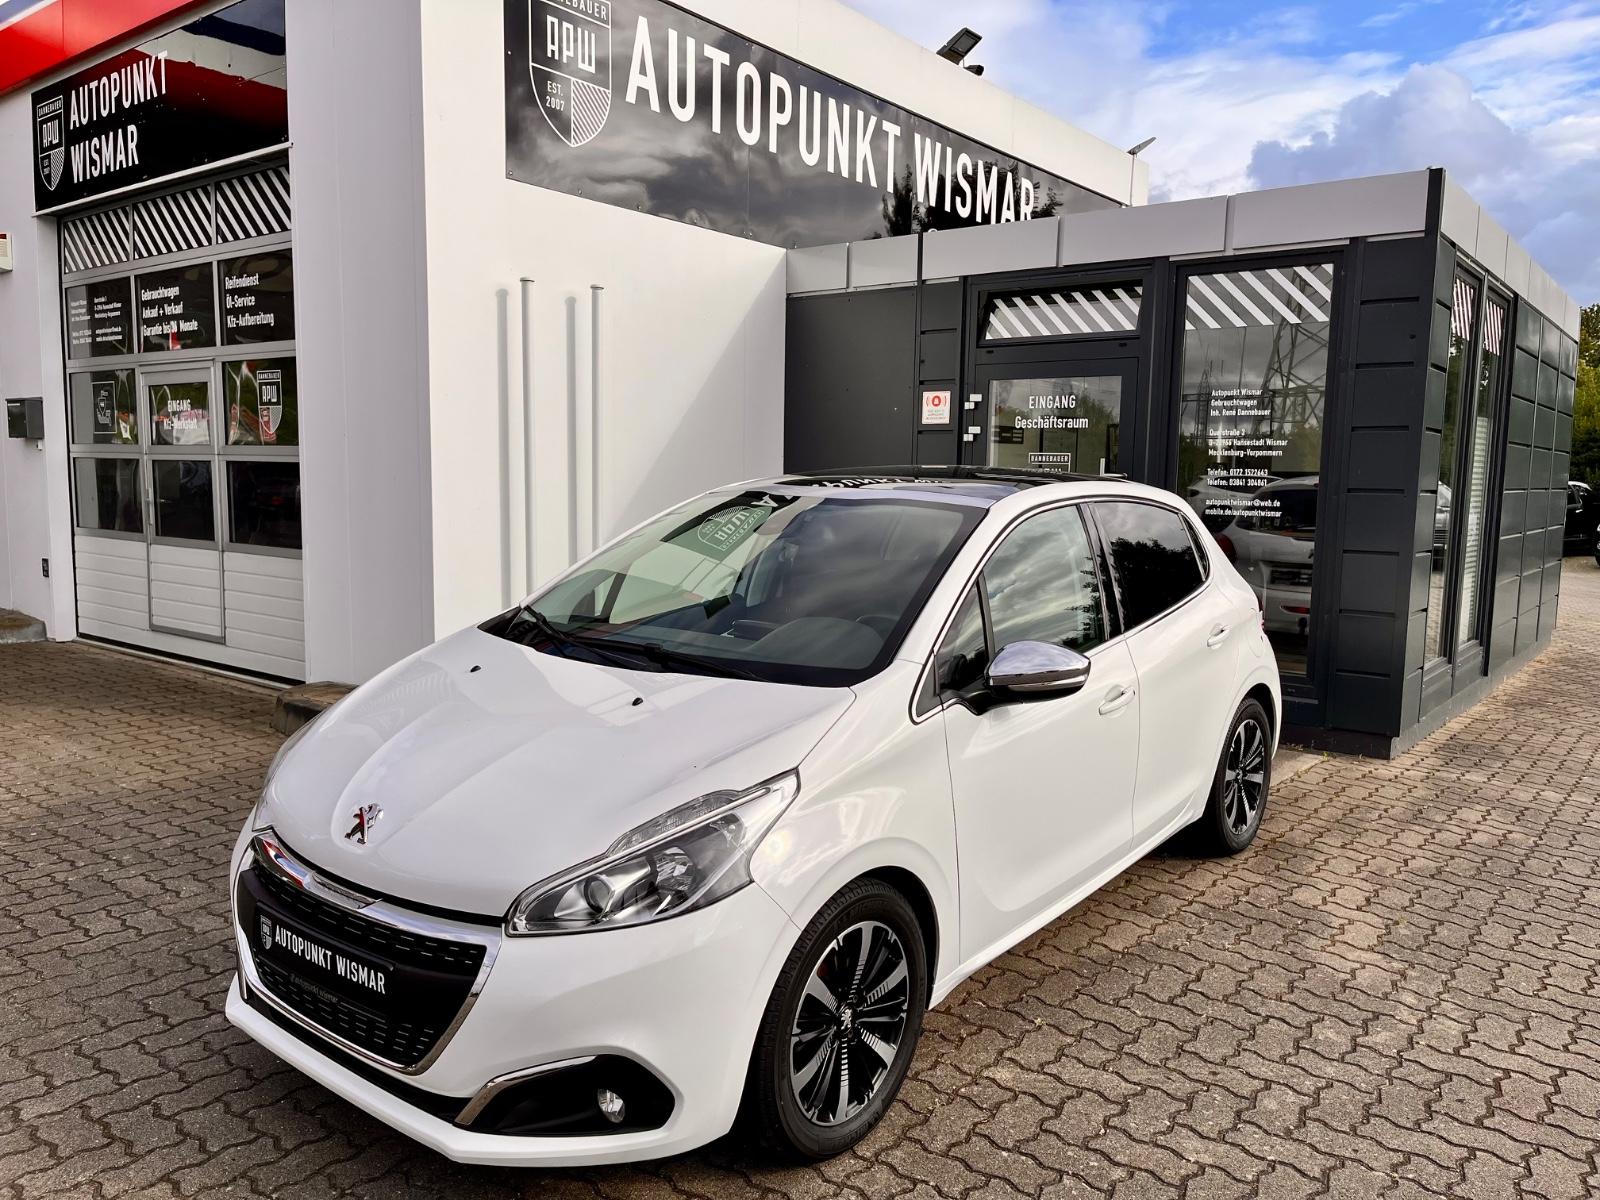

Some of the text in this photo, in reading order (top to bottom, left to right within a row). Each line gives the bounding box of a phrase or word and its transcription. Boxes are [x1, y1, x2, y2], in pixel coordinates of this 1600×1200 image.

[546, 14, 596, 74] APW
[70, 50, 168, 130] AUTOPUNKT
[547, 80, 564, 96] EST.
[545, 95, 565, 111] 2007
[625, 15, 1034, 225] AUTOPUNKT WISMAR
[70, 124, 139, 184] WISMAR
[225, 272, 260, 290] Reifendienst
[141, 286, 180, 301] Gebrauchtwagen
[226, 293, 256, 309] Öl-Service
[142, 304, 159, 319] Ankauf
[164, 301, 184, 316] Verkauf
[143, 322, 162, 337] Garantie
[179, 318, 199, 332] Monate
[227, 312, 275, 328] Kfz-Aufbereitung
[1211, 388, 1263, 398] Autopunkt Wismar
[1028, 395, 1076, 409] EINGANG
[1210, 399, 1258, 407] Gebrauchtwagen
[1222, 408, 1237, 416] René
[1237, 408, 1271, 416] Dannebauer
[1014, 415, 1089, 429] Geschäftsraum
[1233, 438, 1265, 446] Hansestadt
[1265, 438, 1288, 446] Wismar
[1208, 448, 1283, 457] Mecklenburg-Vorpommern
[1229, 468, 1243, 476] 0172
[1229, 478, 1246, 486] 03841
[1205, 498, 1281, 507] autopunktwismar@web.de
[1204, 508, 1283, 517] mobile.de/autopunktwismar
[275, 924, 332, 970] AUTOPUNKT
[336, 954, 386, 995] WISMAR
